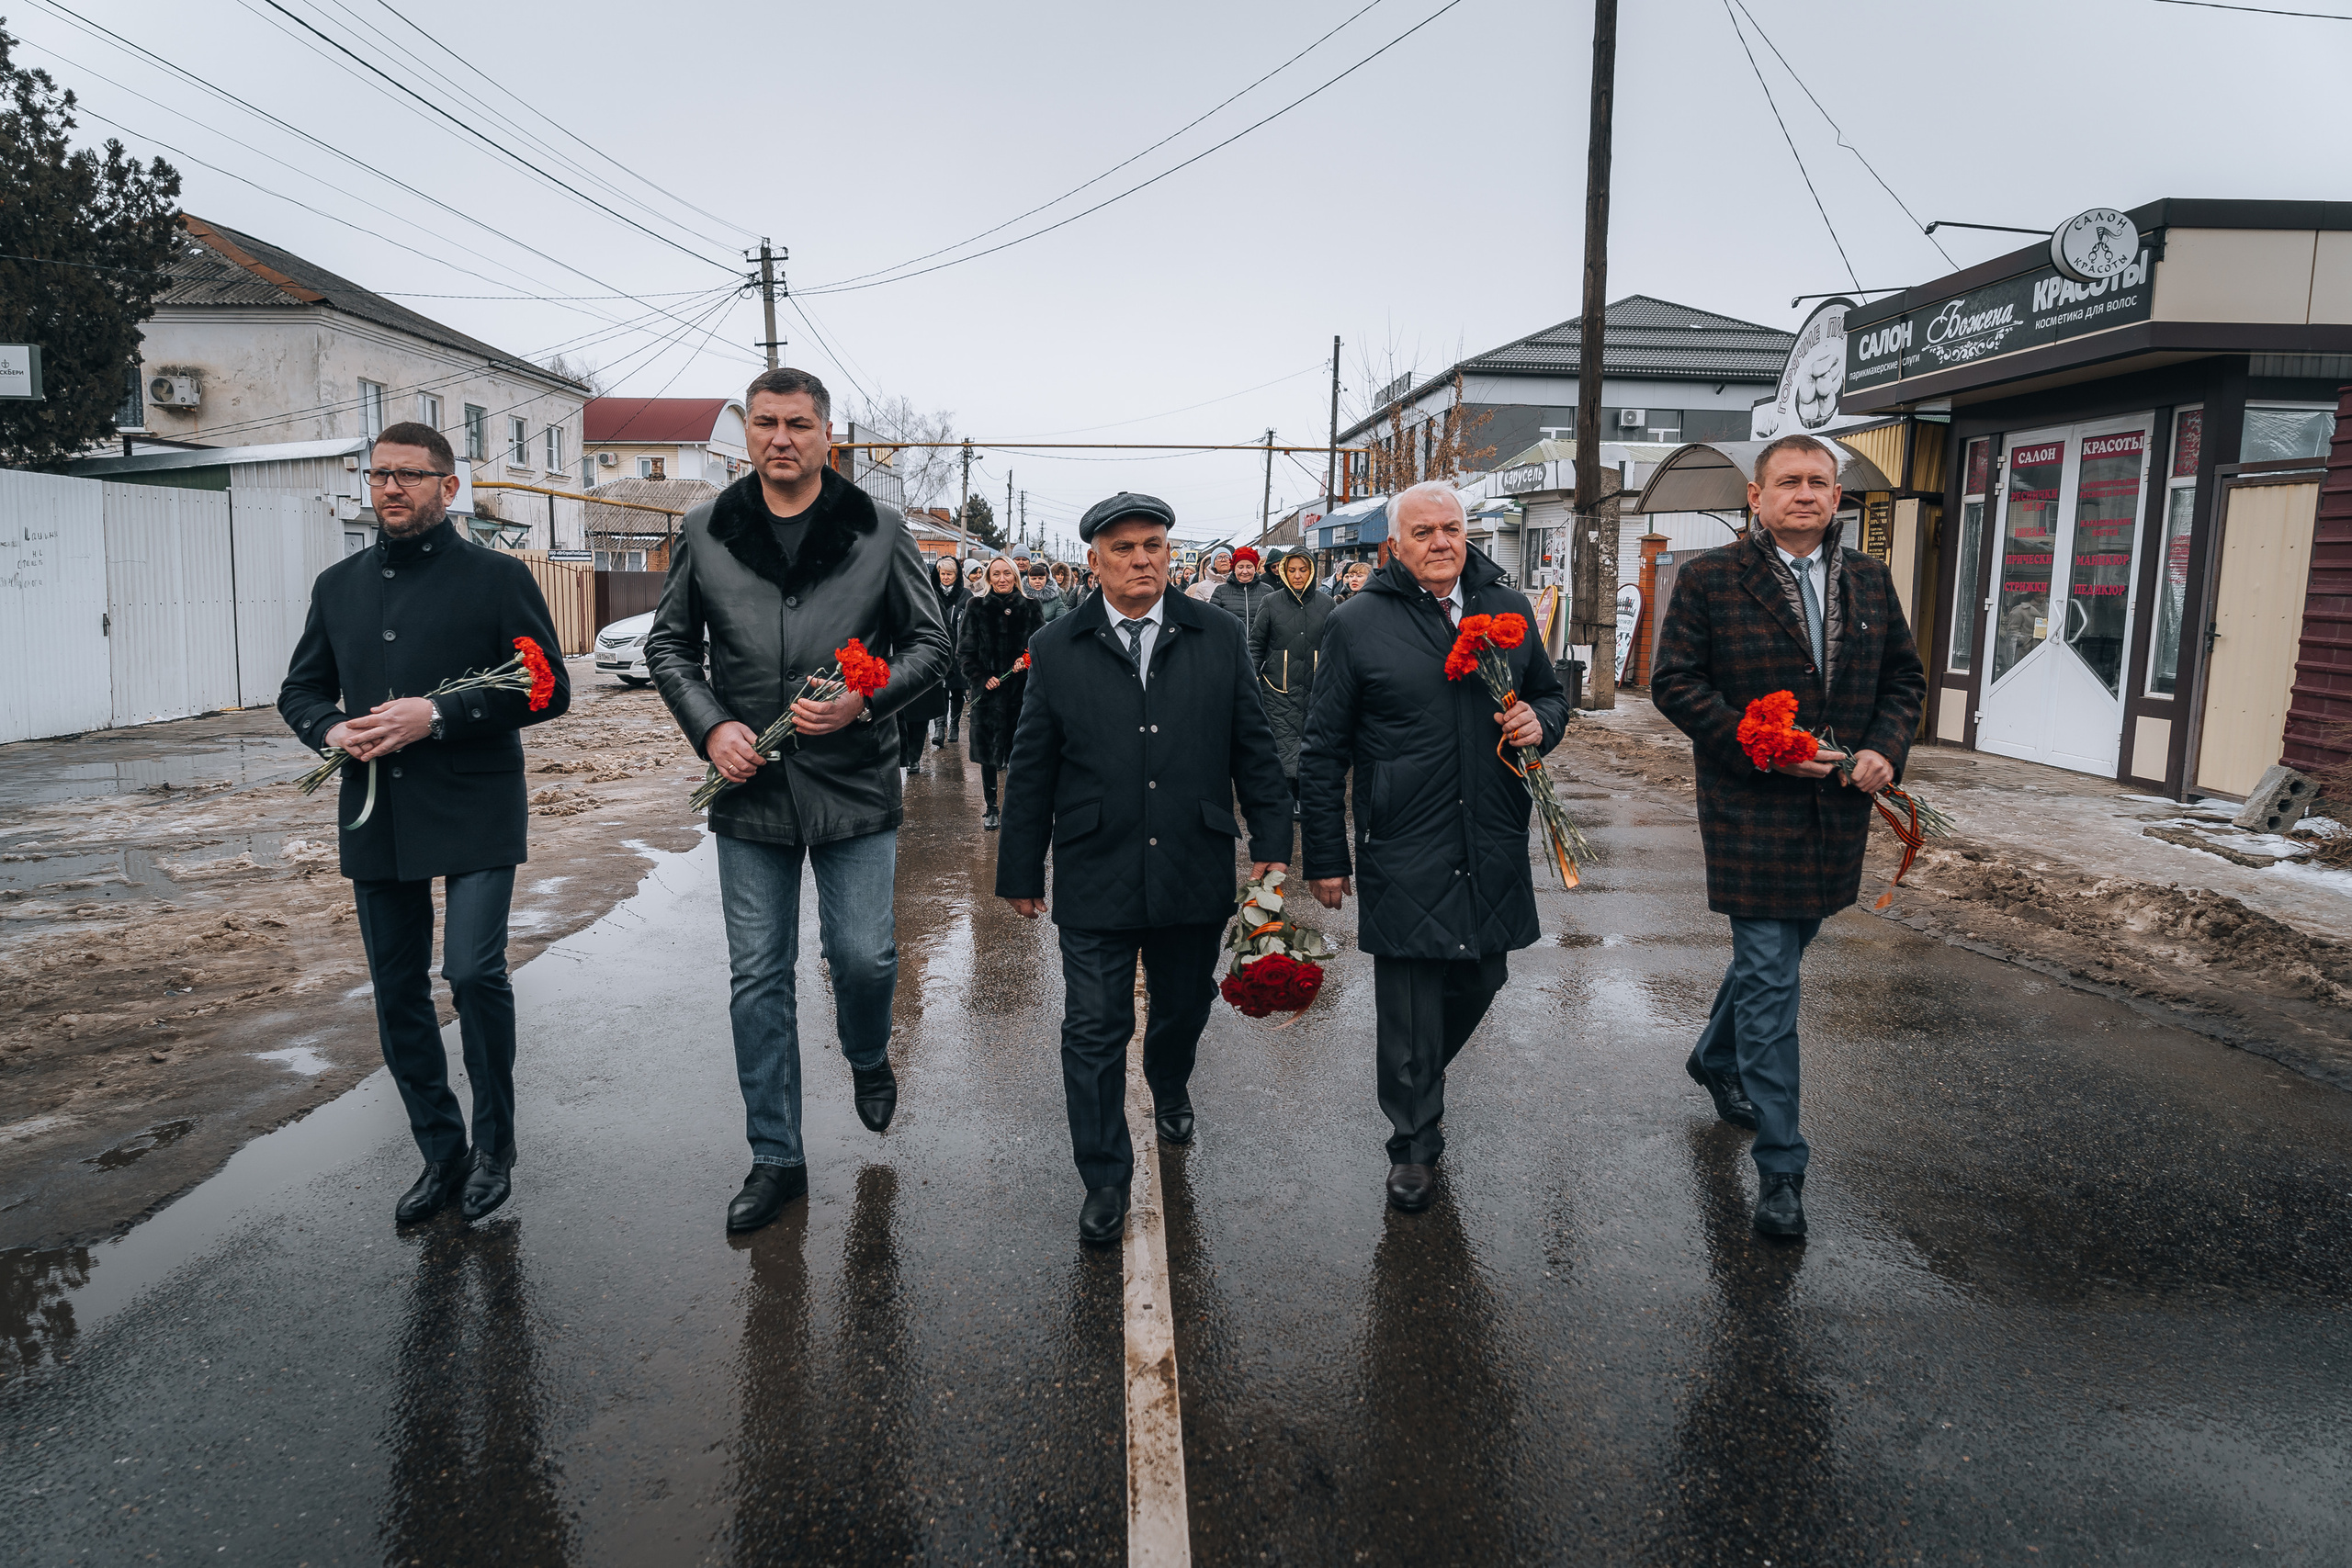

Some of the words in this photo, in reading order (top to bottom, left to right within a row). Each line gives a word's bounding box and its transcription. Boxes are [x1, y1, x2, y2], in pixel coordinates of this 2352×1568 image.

[2075, 212, 2127, 231] САЛОН
[2074, 254, 2128, 273] КРАСОТЫ
[1927, 299, 2014, 344] Божена
[2035, 309, 2083, 330] косметика
[2085, 303, 2104, 320] для
[2106, 295, 2137, 312] волос
[1859, 321, 1913, 361] САЛОН
[1778, 324, 1821, 414] ГОРЯЧИЕ
[1826, 317, 1847, 340] ПИ
[1849, 359, 1898, 381] парикмахерские
[1900, 354, 1920, 367] слуги
[2018, 447, 2056, 464] САЛОН
[2083, 436, 2144, 455] КРАСОТЫ
[2010, 489, 2058, 502] РЕСНИЧКИ
[2014, 526, 2046, 537] ВИЗАЖ
[2006, 554, 2052, 565] ПРИЧЕСКИ
[2075, 555, 2130, 566] МАНИКЮР
[2004, 581, 2047, 592] СТРИЖКИ
[2074, 584, 2125, 596] ПЕДИКЮР
